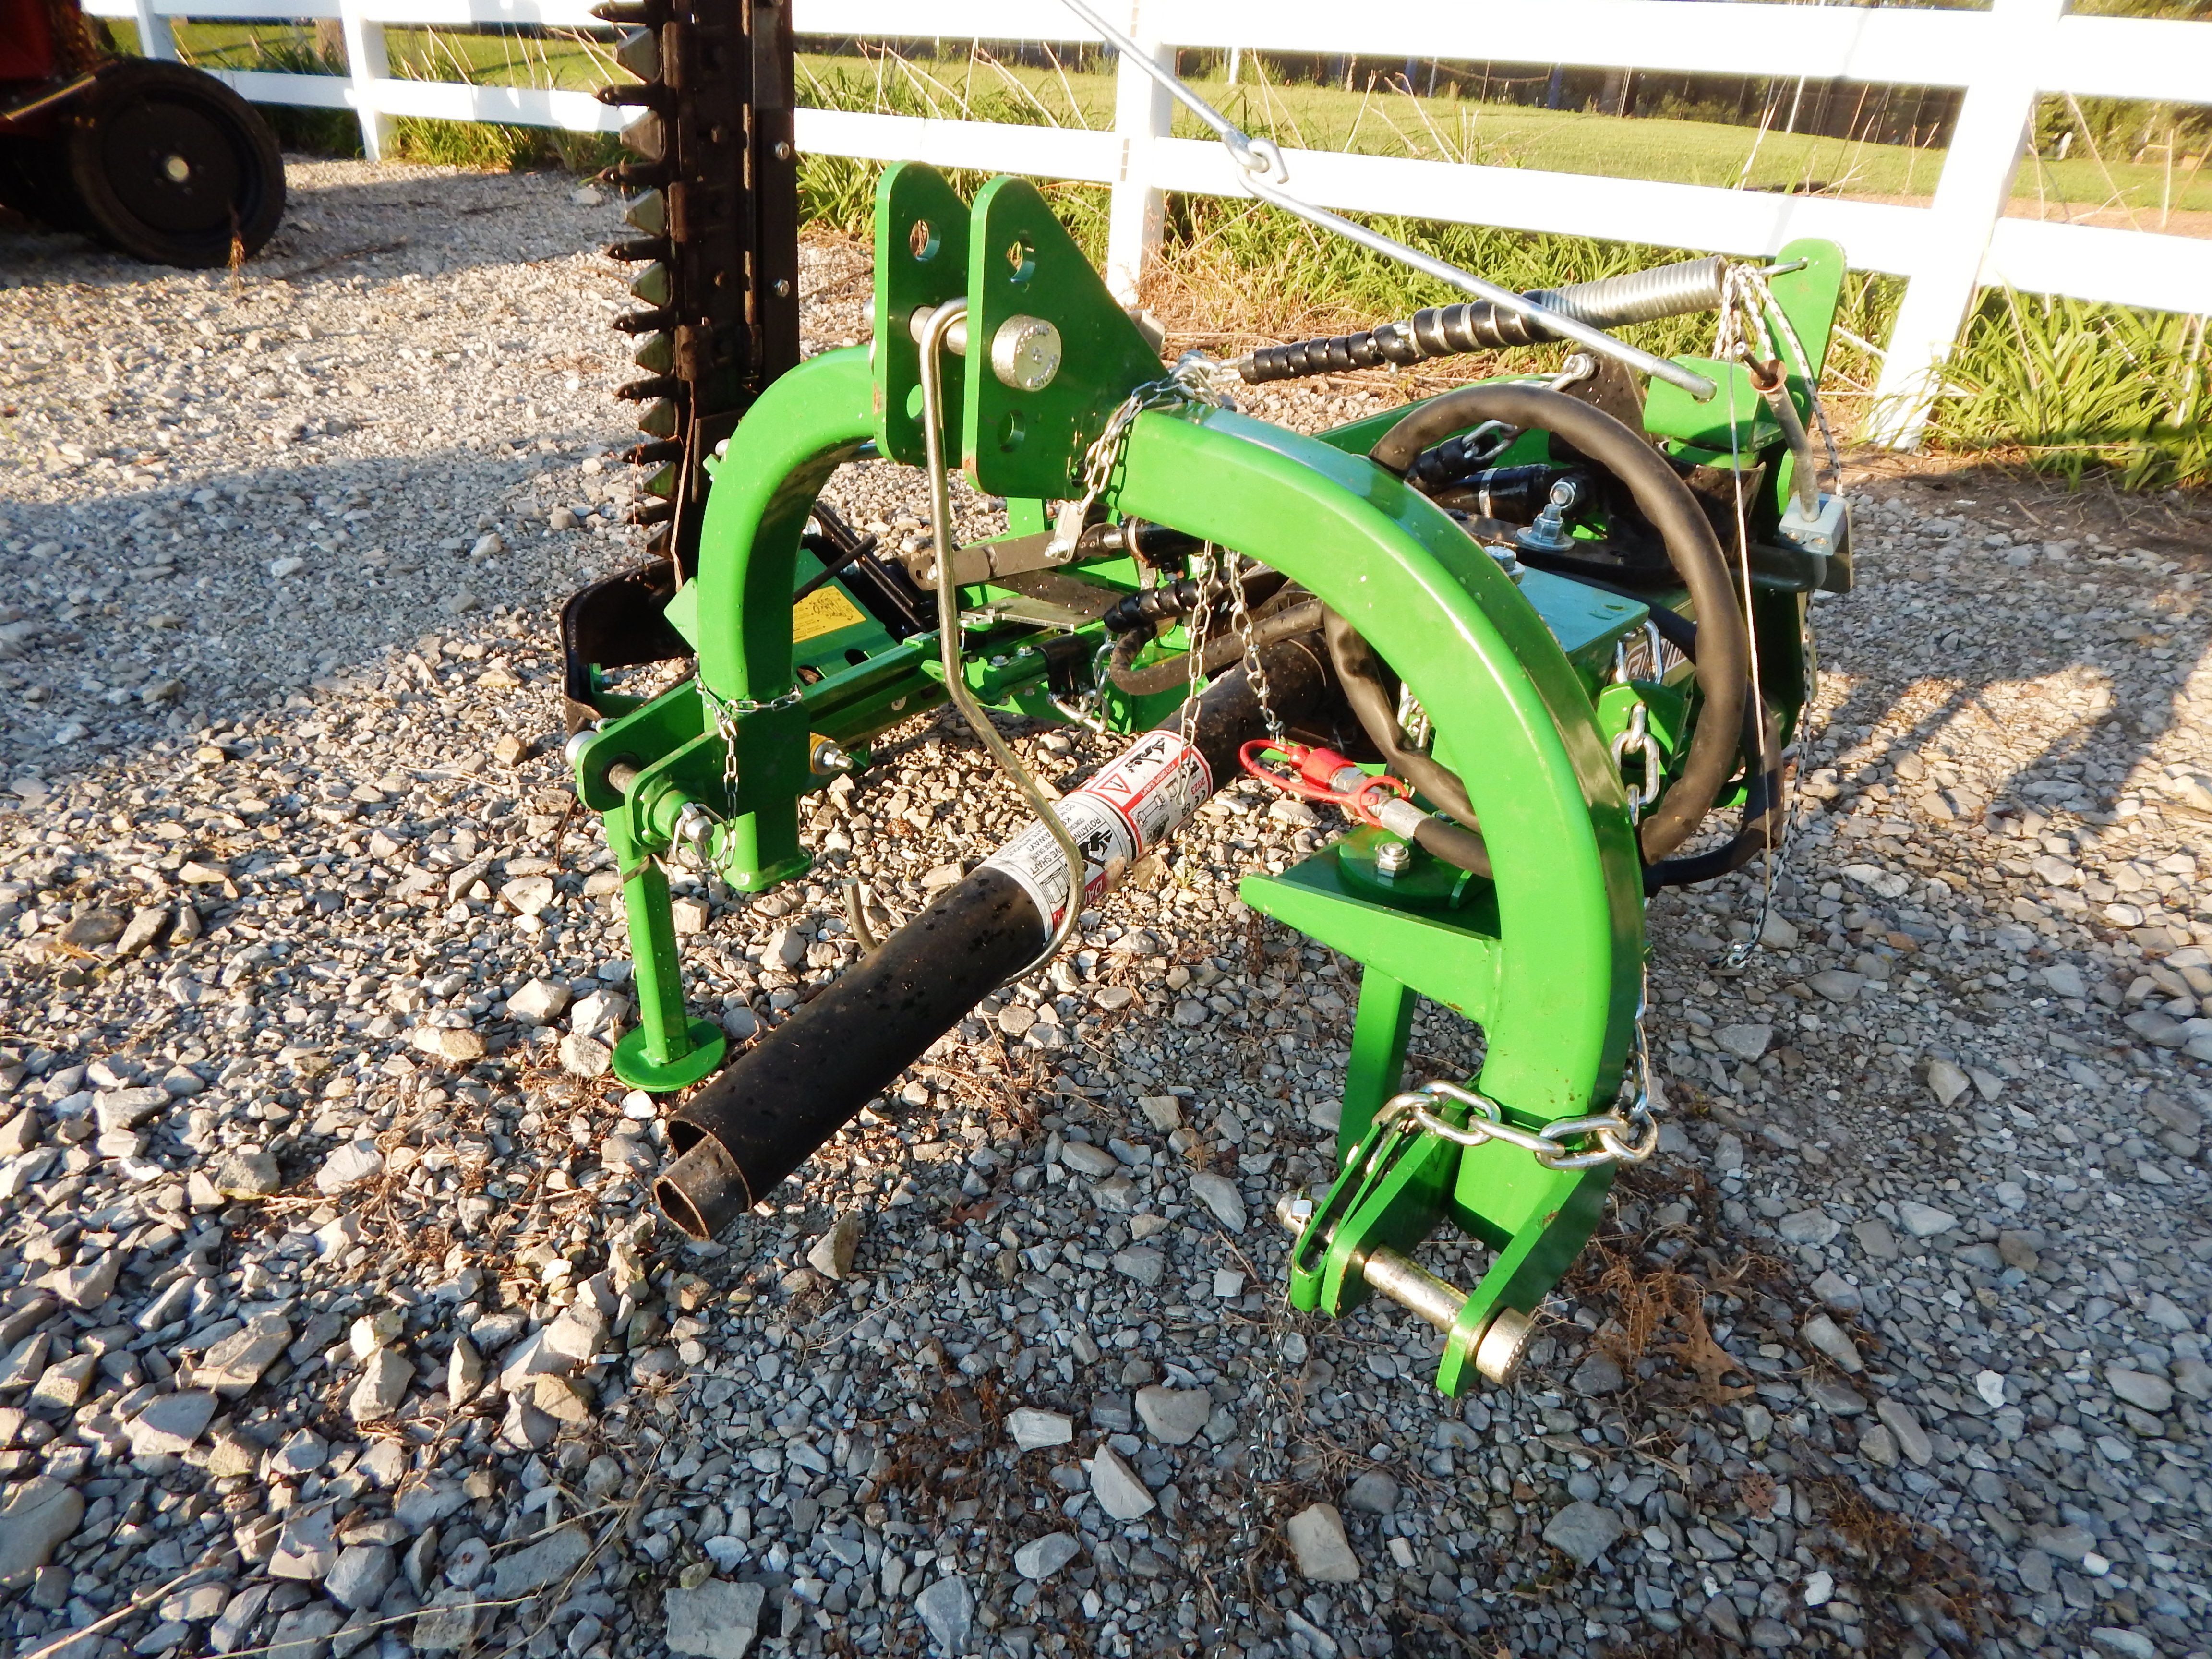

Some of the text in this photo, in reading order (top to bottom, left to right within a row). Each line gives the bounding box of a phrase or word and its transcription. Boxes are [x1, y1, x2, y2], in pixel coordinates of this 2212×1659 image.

[1141, 763, 1176, 796] PTO DRIVE SHAFT
[1190, 776, 1206, 795] 2023
[1067, 817, 1085, 832] CONTAC
[1026, 831, 1051, 852] AWAY!
[1029, 847, 1046, 861] DEATH
[1050, 846, 1063, 858] IVE
[1030, 854, 1052, 875] SHAFT
